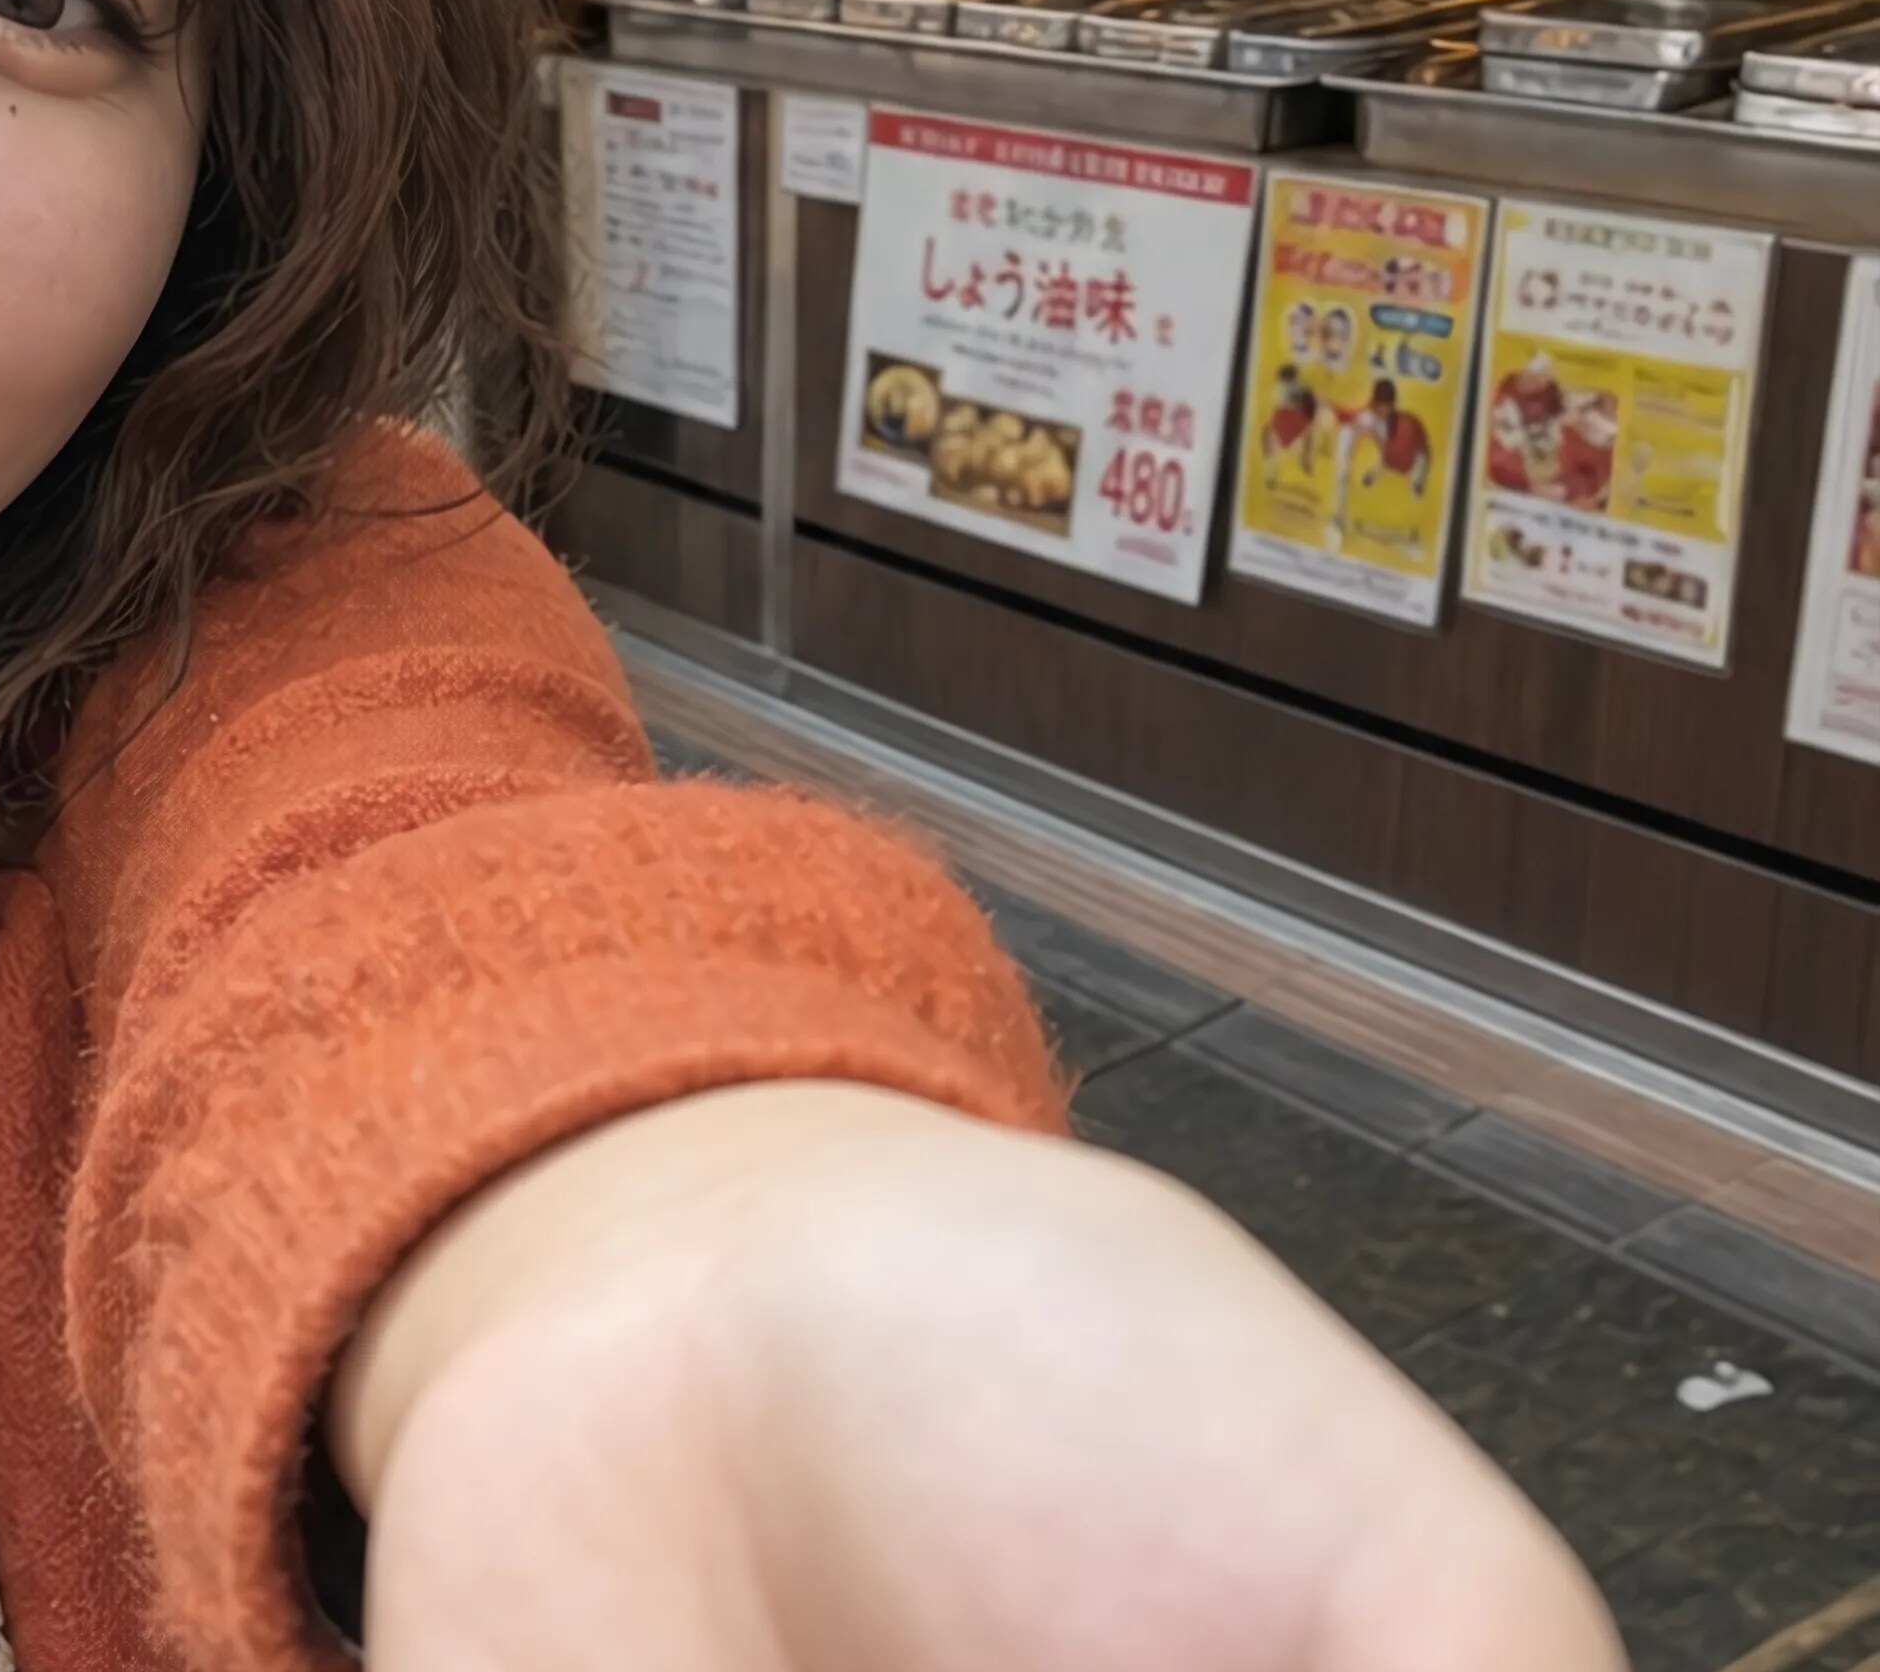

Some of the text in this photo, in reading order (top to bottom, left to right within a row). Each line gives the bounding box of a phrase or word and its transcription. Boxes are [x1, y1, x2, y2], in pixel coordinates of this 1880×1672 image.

[921, 235, 1138, 345] しょう油味
